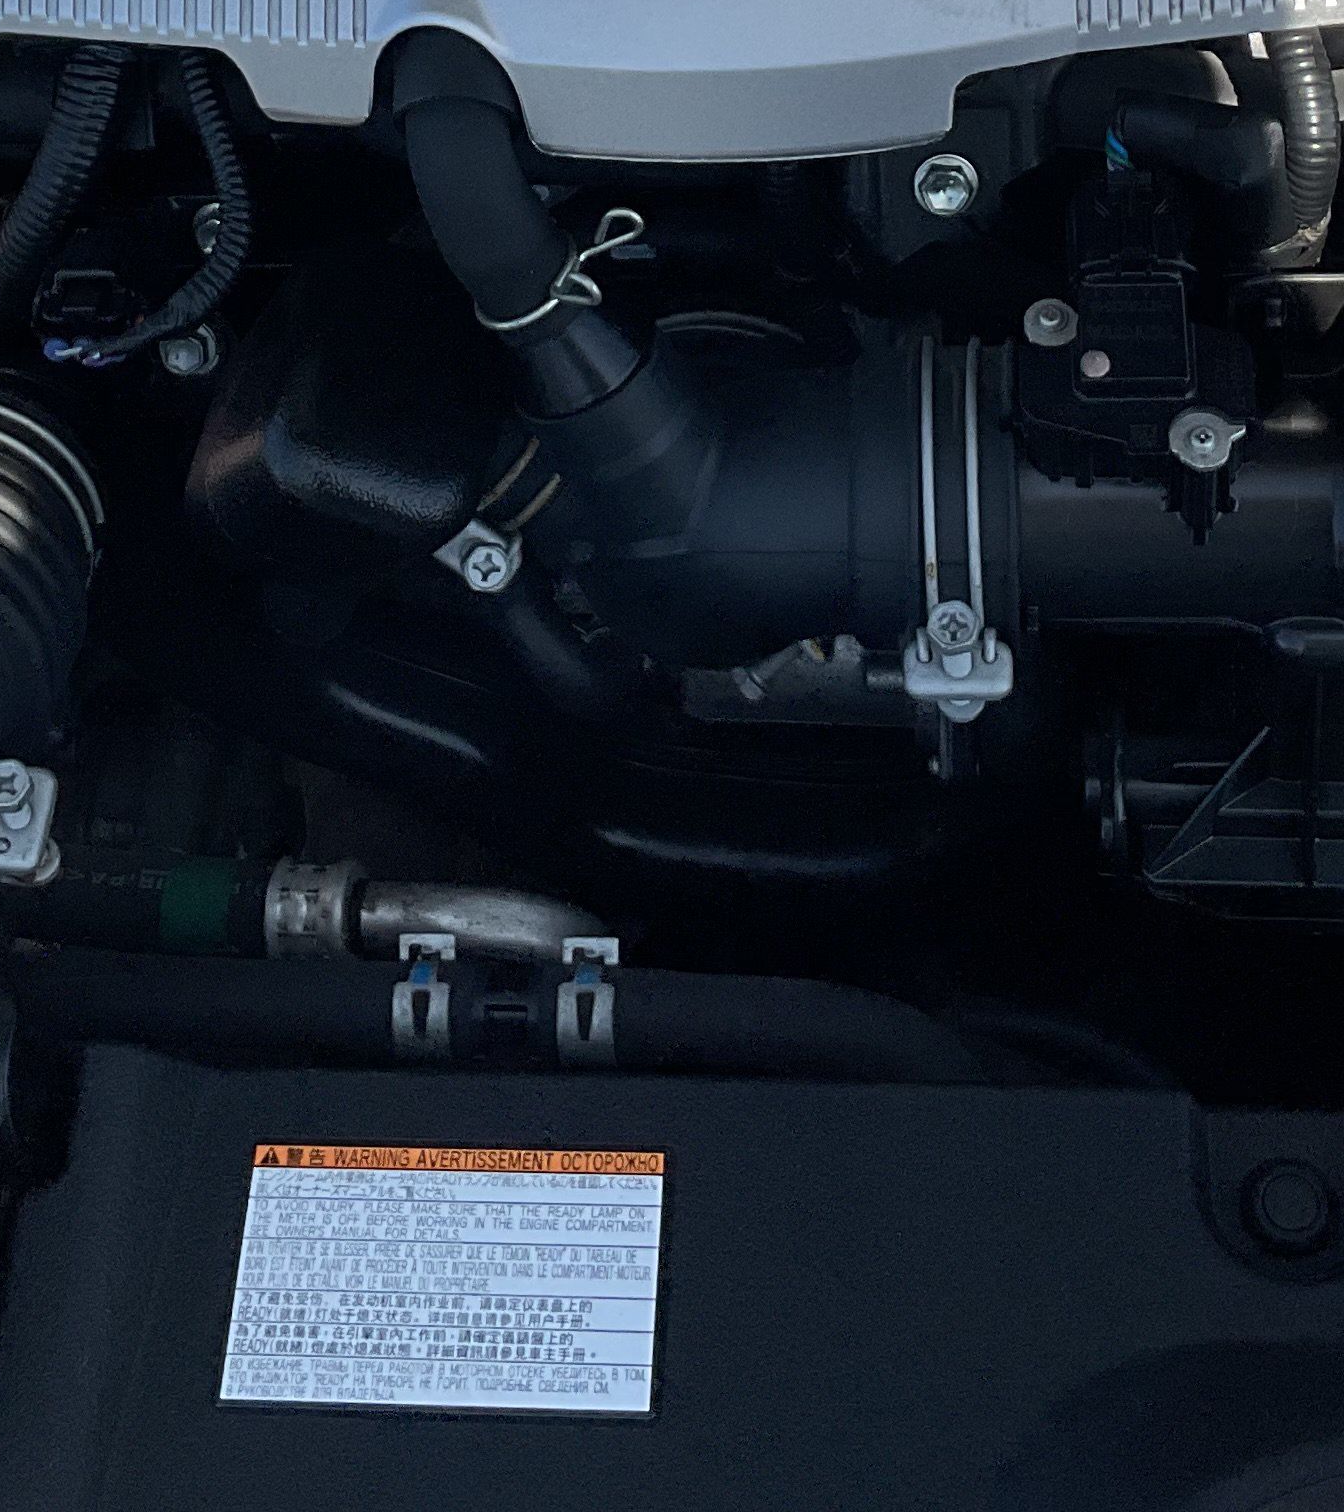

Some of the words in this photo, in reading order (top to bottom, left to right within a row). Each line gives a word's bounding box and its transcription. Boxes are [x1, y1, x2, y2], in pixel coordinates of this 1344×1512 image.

[332, 1148, 410, 1167] WARNING
[415, 1150, 553, 1169] AVERTISSEMENT
[560, 1153, 659, 1172] ОСТОРОЖНО
[253, 1199, 268, 1210] TO
[274, 1199, 309, 1211] AVOID
[363, 1201, 404, 1213] PLEASE
[410, 1202, 440, 1214] MAKE
[447, 1203, 477, 1214] SURE
[485, 1204, 512, 1215] THAT
[520, 1205, 540, 1216] THE
[547, 1205, 585, 1217] READY
[590, 1206, 622, 1218] LAMP
[628, 1207, 645, 1218] ON
[251, 1212, 272, 1223] THE
[278, 1212, 315, 1224] METER
[322, 1213, 332, 1224] IS
[337, 1213, 360, 1225] OFF
[366, 1214, 409, 1226] BEFORE
[415, 1215, 467, 1227] WORKING
[474, 1217, 485, 1228] IN
[492, 1217, 512, 1228] THE
[519, 1218, 559, 1229] ENGINE
[249, 1224, 269, 1235] SEE
[330, 1226, 377, 1238] MANUAL
[384, 1227, 408, 1239] FOR
